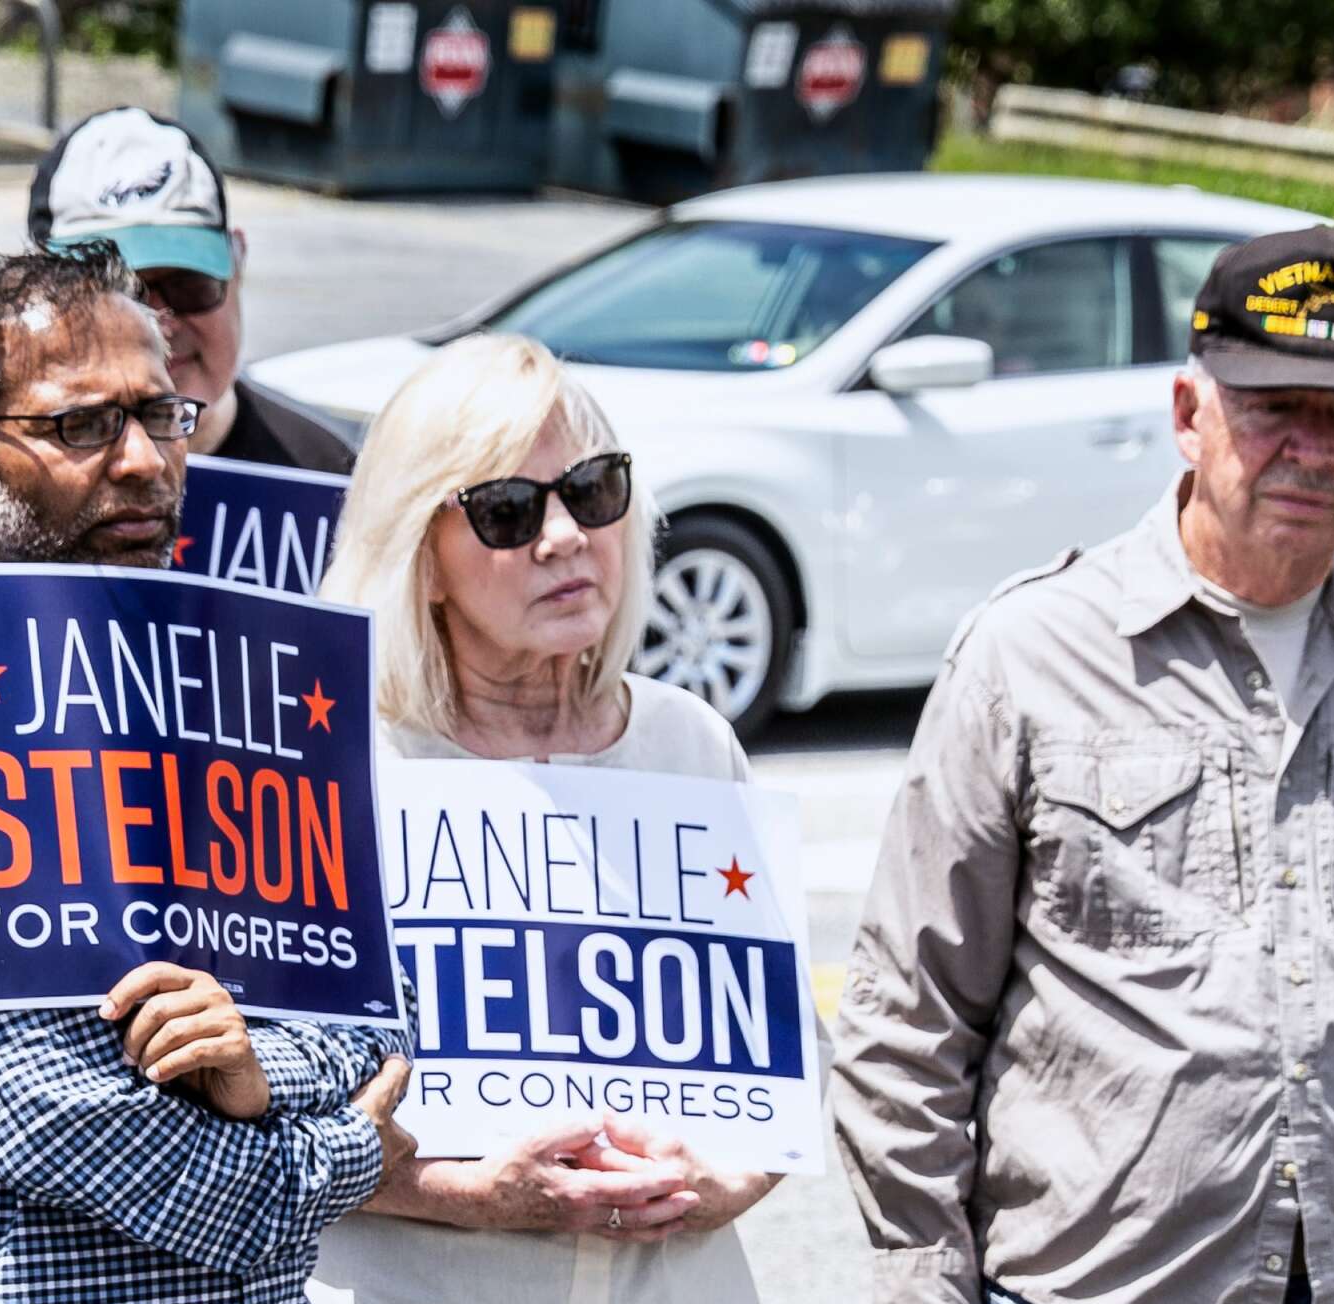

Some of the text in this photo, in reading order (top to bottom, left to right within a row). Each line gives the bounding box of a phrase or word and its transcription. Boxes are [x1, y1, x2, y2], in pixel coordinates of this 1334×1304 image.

[1245, 295, 1299, 315] DESERT
[14, 617, 303, 760] JANELLE
[389, 809, 714, 925] JANELLE
[122, 900, 358, 970] CONGRESS
[395, 926, 771, 1069] TELSON
[478, 1071, 774, 1122] CONGRESS
